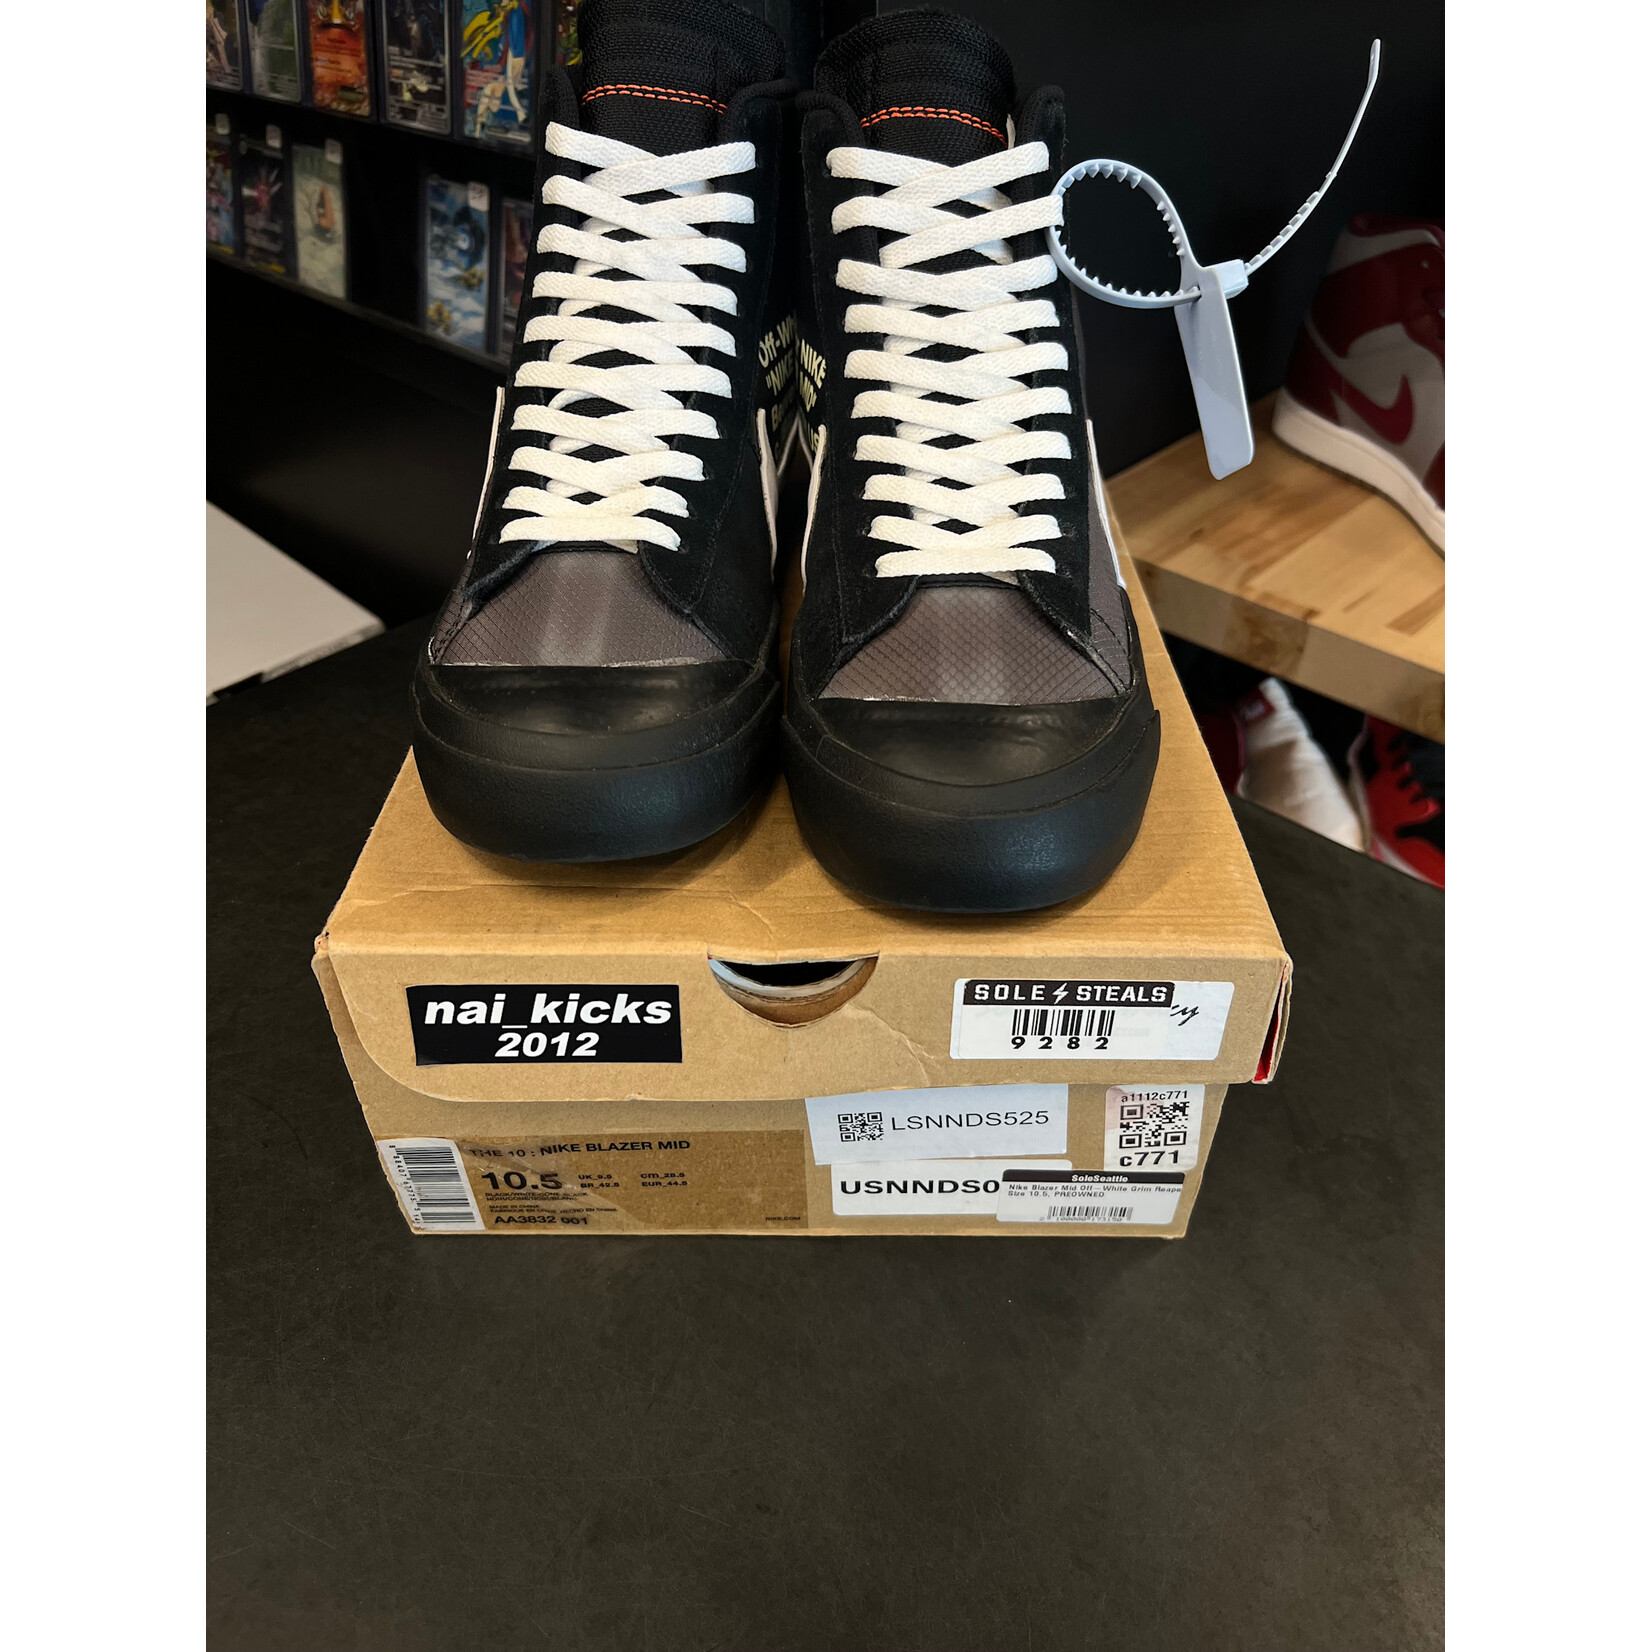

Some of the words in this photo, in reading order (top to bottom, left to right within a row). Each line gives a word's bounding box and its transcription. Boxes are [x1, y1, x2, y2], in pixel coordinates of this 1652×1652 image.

[974, 984, 1046, 1001] SOLE
[1075, 985, 1168, 1003] STEALS
[424, 993, 673, 1029] nai_kicks
[494, 1031, 600, 1057] 2012
[1121, 1090, 1188, 1103] a1112c771
[891, 1110, 1050, 1131] LSNNDS525
[540, 1144, 581, 1157] NIKE
[585, 1141, 653, 1152] BLAZER
[658, 1140, 690, 1150] MID
[1119, 1150, 1179, 1167] c771
[481, 1171, 563, 1190] 10.5
[642, 1180, 688, 1188] EUR_44.5
[840, 1179, 1000, 1195] USNNDS0
[1071, 1174, 1129, 1183] SoleSeattle
[495, 1215, 557, 1224] AA3832
[561, 1216, 588, 1225] 001
